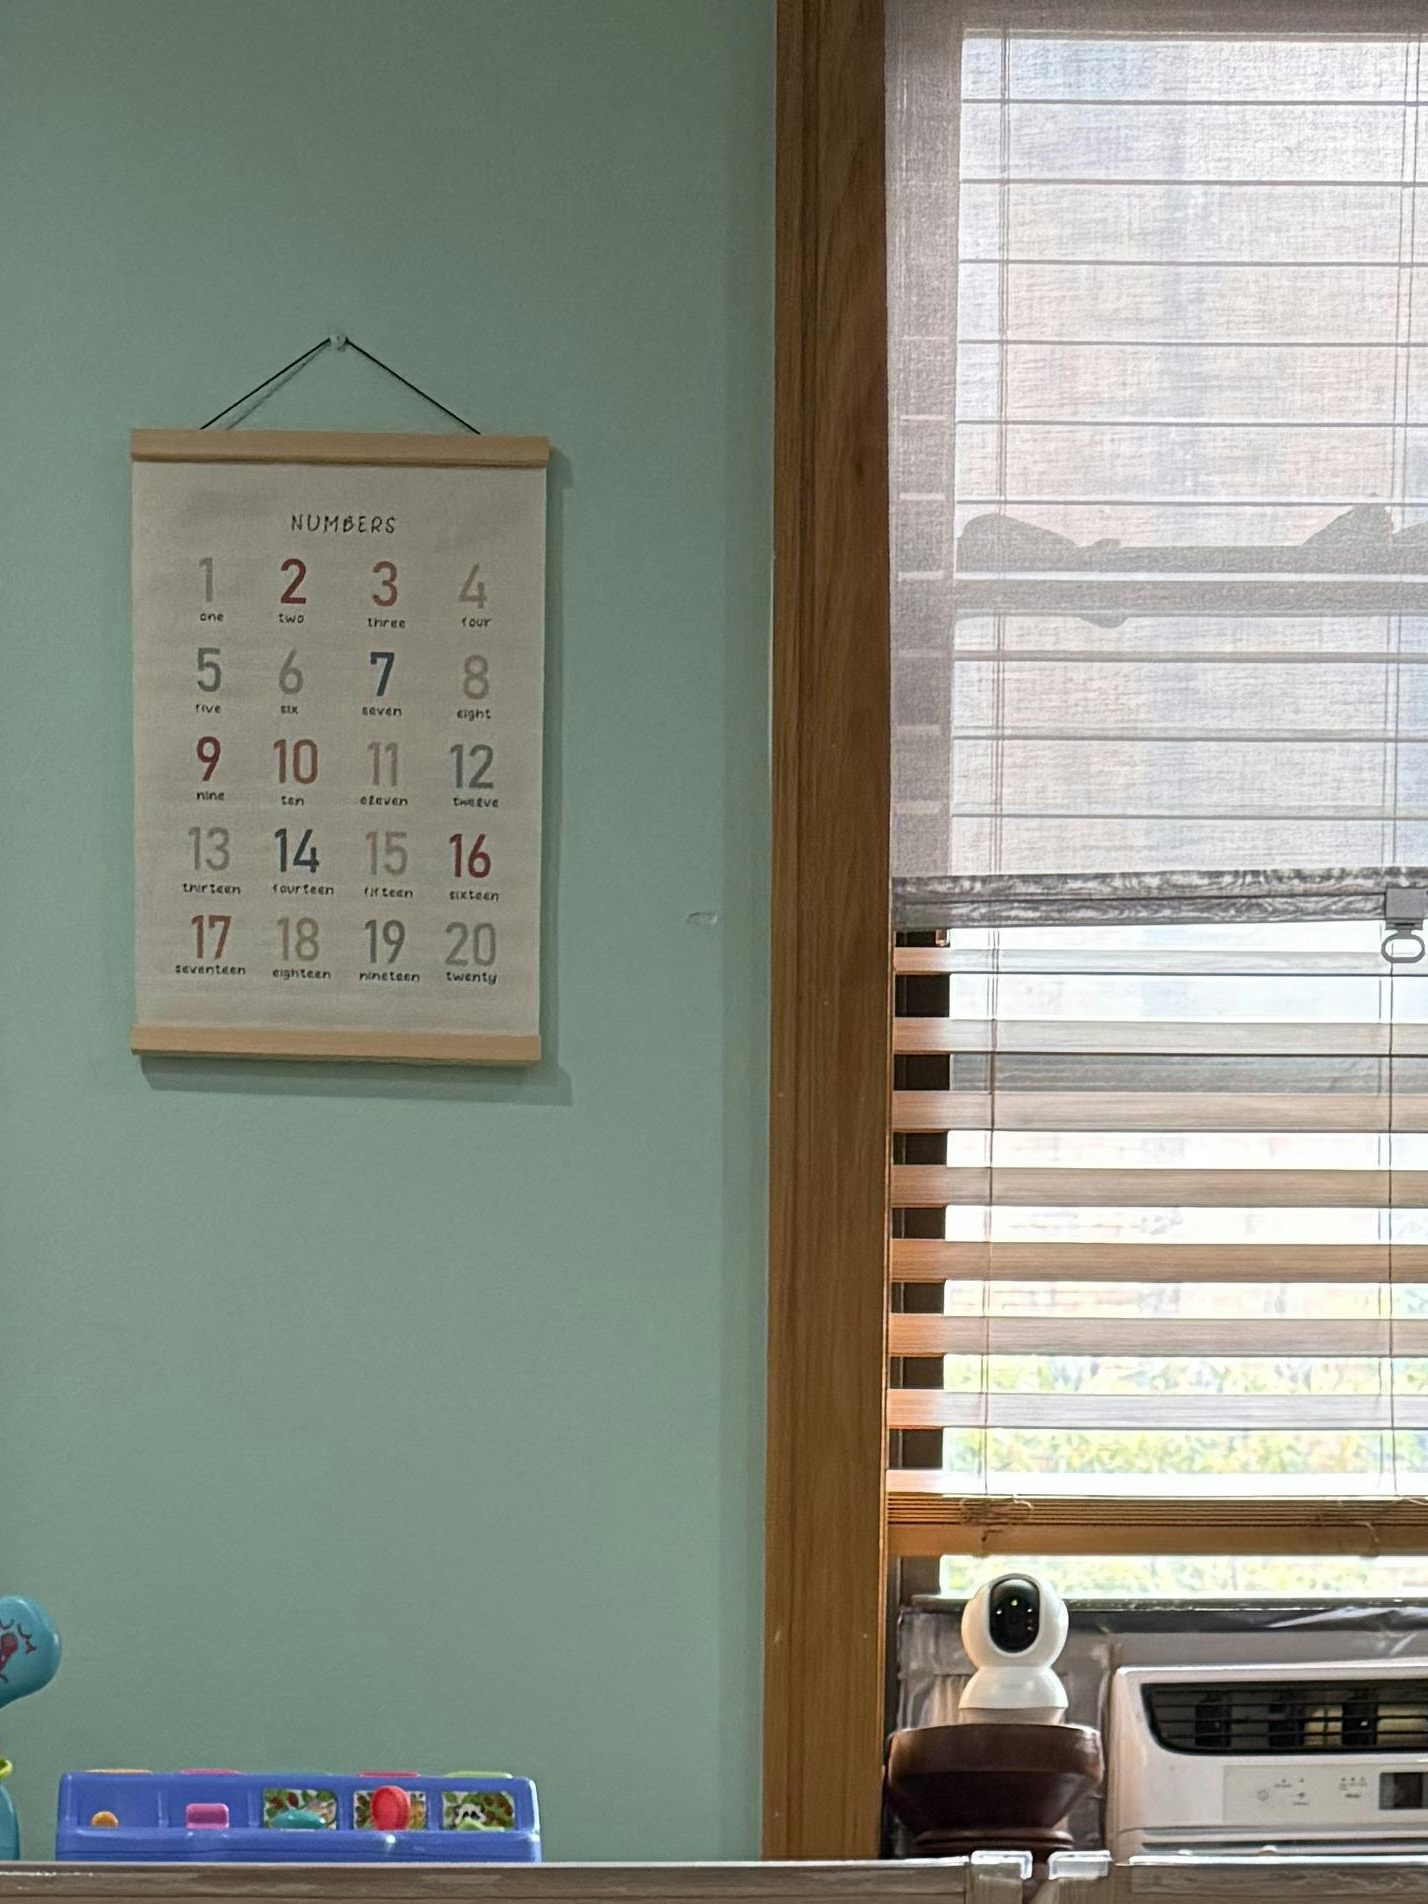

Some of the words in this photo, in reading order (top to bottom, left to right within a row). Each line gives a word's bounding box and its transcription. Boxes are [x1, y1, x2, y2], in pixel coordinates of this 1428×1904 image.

[291, 514, 397, 534] NUMBERS
[198, 557, 214, 603] 1
[279, 558, 307, 605] 2
[372, 560, 398, 607] 3
[458, 563, 488, 609] 4
[199, 611, 224, 623] one
[278, 612, 304, 624] two
[367, 616, 406, 629] three
[461, 616, 492, 628] four
[196, 647, 222, 693] 5
[278, 649, 304, 695] 6
[369, 651, 395, 697] 7
[463, 654, 489, 700] 8
[195, 703, 221, 715] five
[280, 704, 299, 715] six
[361, 705, 402, 717] seven
[456, 708, 492, 722] eight
[196, 736, 221, 782] 9
[273, 738, 319, 784] 10
[367, 741, 399, 787] 11
[449, 744, 495, 789] 12
[196, 790, 225, 802] nine
[281, 795, 305, 807] ten
[359, 795, 409, 808] eleven
[188, 826, 231, 872] 13
[274, 827, 320, 874] 14
[365, 831, 409, 877] 15
[448, 833, 492, 879] 16
[182, 882, 242, 896] thirteen
[272, 883, 335, 897] fourteen
[363, 886, 414, 899] fifteen
[448, 889, 500, 902] sixteen
[190, 914, 232, 961] 17
[276, 916, 320, 962] 18
[363, 919, 406, 965] 19
[444, 921, 497, 967] 20
[175, 963, 247, 976] seventeen
[272, 968, 332, 981] eighteen
[358, 970, 421, 983] nineteen
[445, 971, 498, 986] twenty
